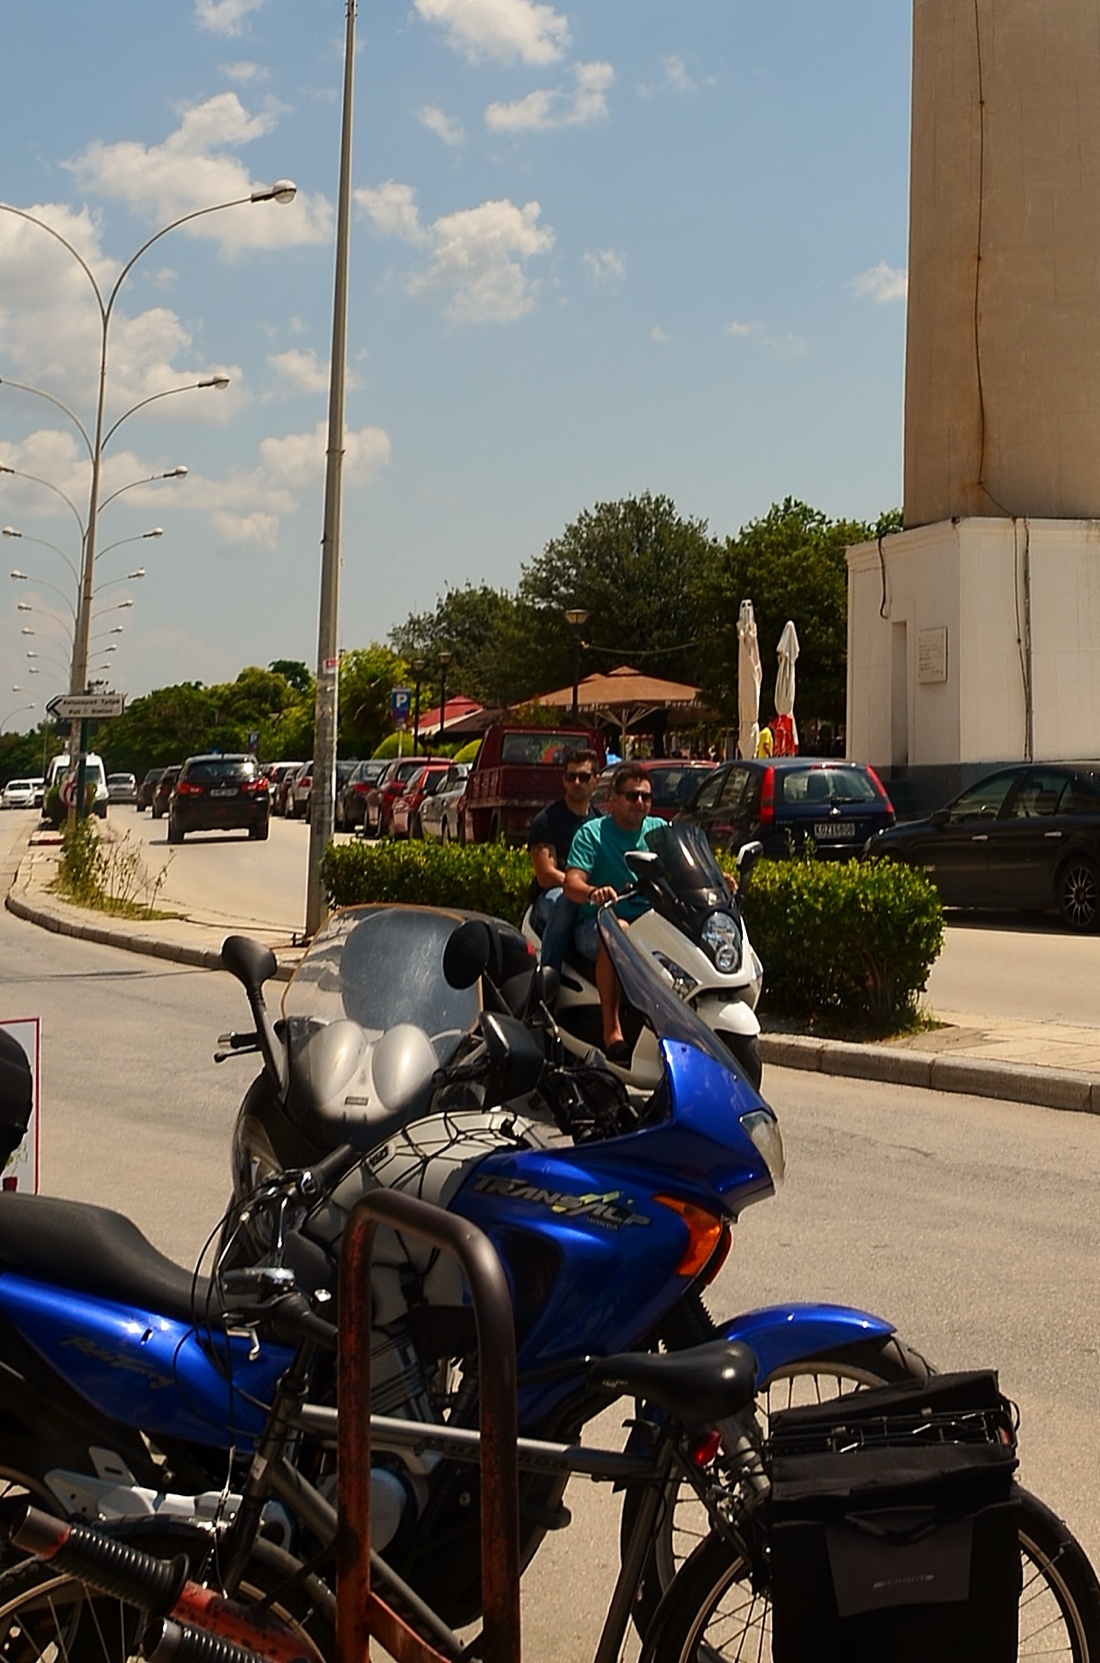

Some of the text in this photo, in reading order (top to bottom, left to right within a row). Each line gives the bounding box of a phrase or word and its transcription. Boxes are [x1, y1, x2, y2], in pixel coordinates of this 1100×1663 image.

[395, 693, 408, 708] P
[474, 1173, 652, 1227] TRANSALP
[586, 1215, 620, 1231] HONDA
